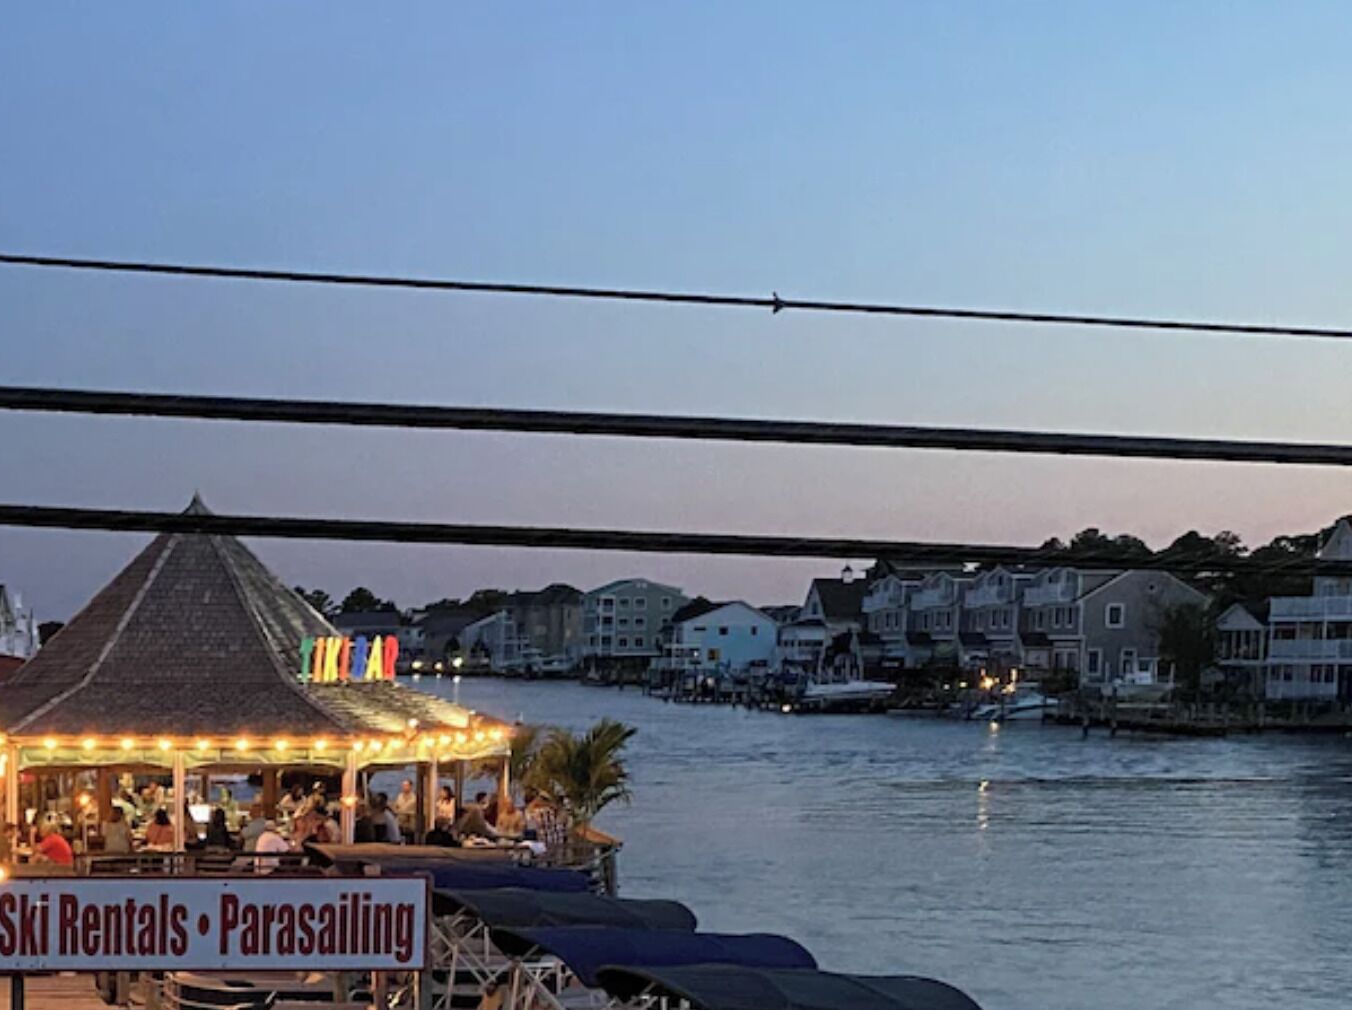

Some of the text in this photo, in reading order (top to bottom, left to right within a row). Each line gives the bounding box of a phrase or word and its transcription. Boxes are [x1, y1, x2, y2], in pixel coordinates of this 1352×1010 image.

[299, 634, 399, 683] TIKI BAR
[58, 893, 188, 957] Rentals
[219, 891, 415, 964] Parasailing
